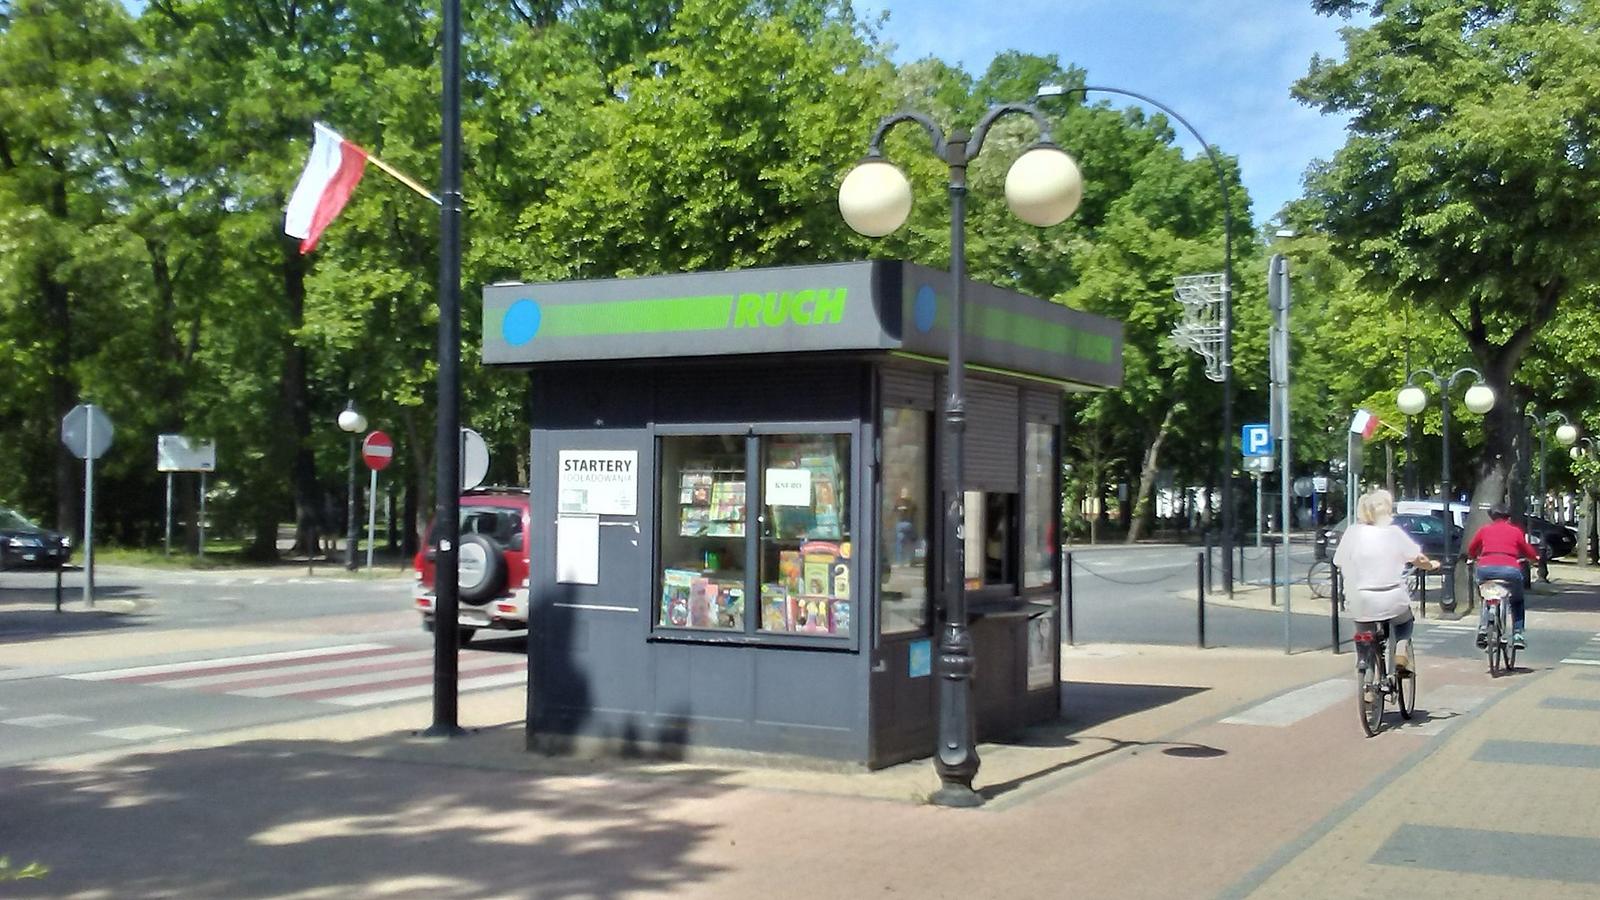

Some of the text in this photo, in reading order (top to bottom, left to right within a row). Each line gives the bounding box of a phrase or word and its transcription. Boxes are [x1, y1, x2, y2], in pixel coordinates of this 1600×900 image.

[734, 287, 848, 328] RUCH
[1250, 428, 1269, 453] P
[564, 459, 632, 472] STARTERY
